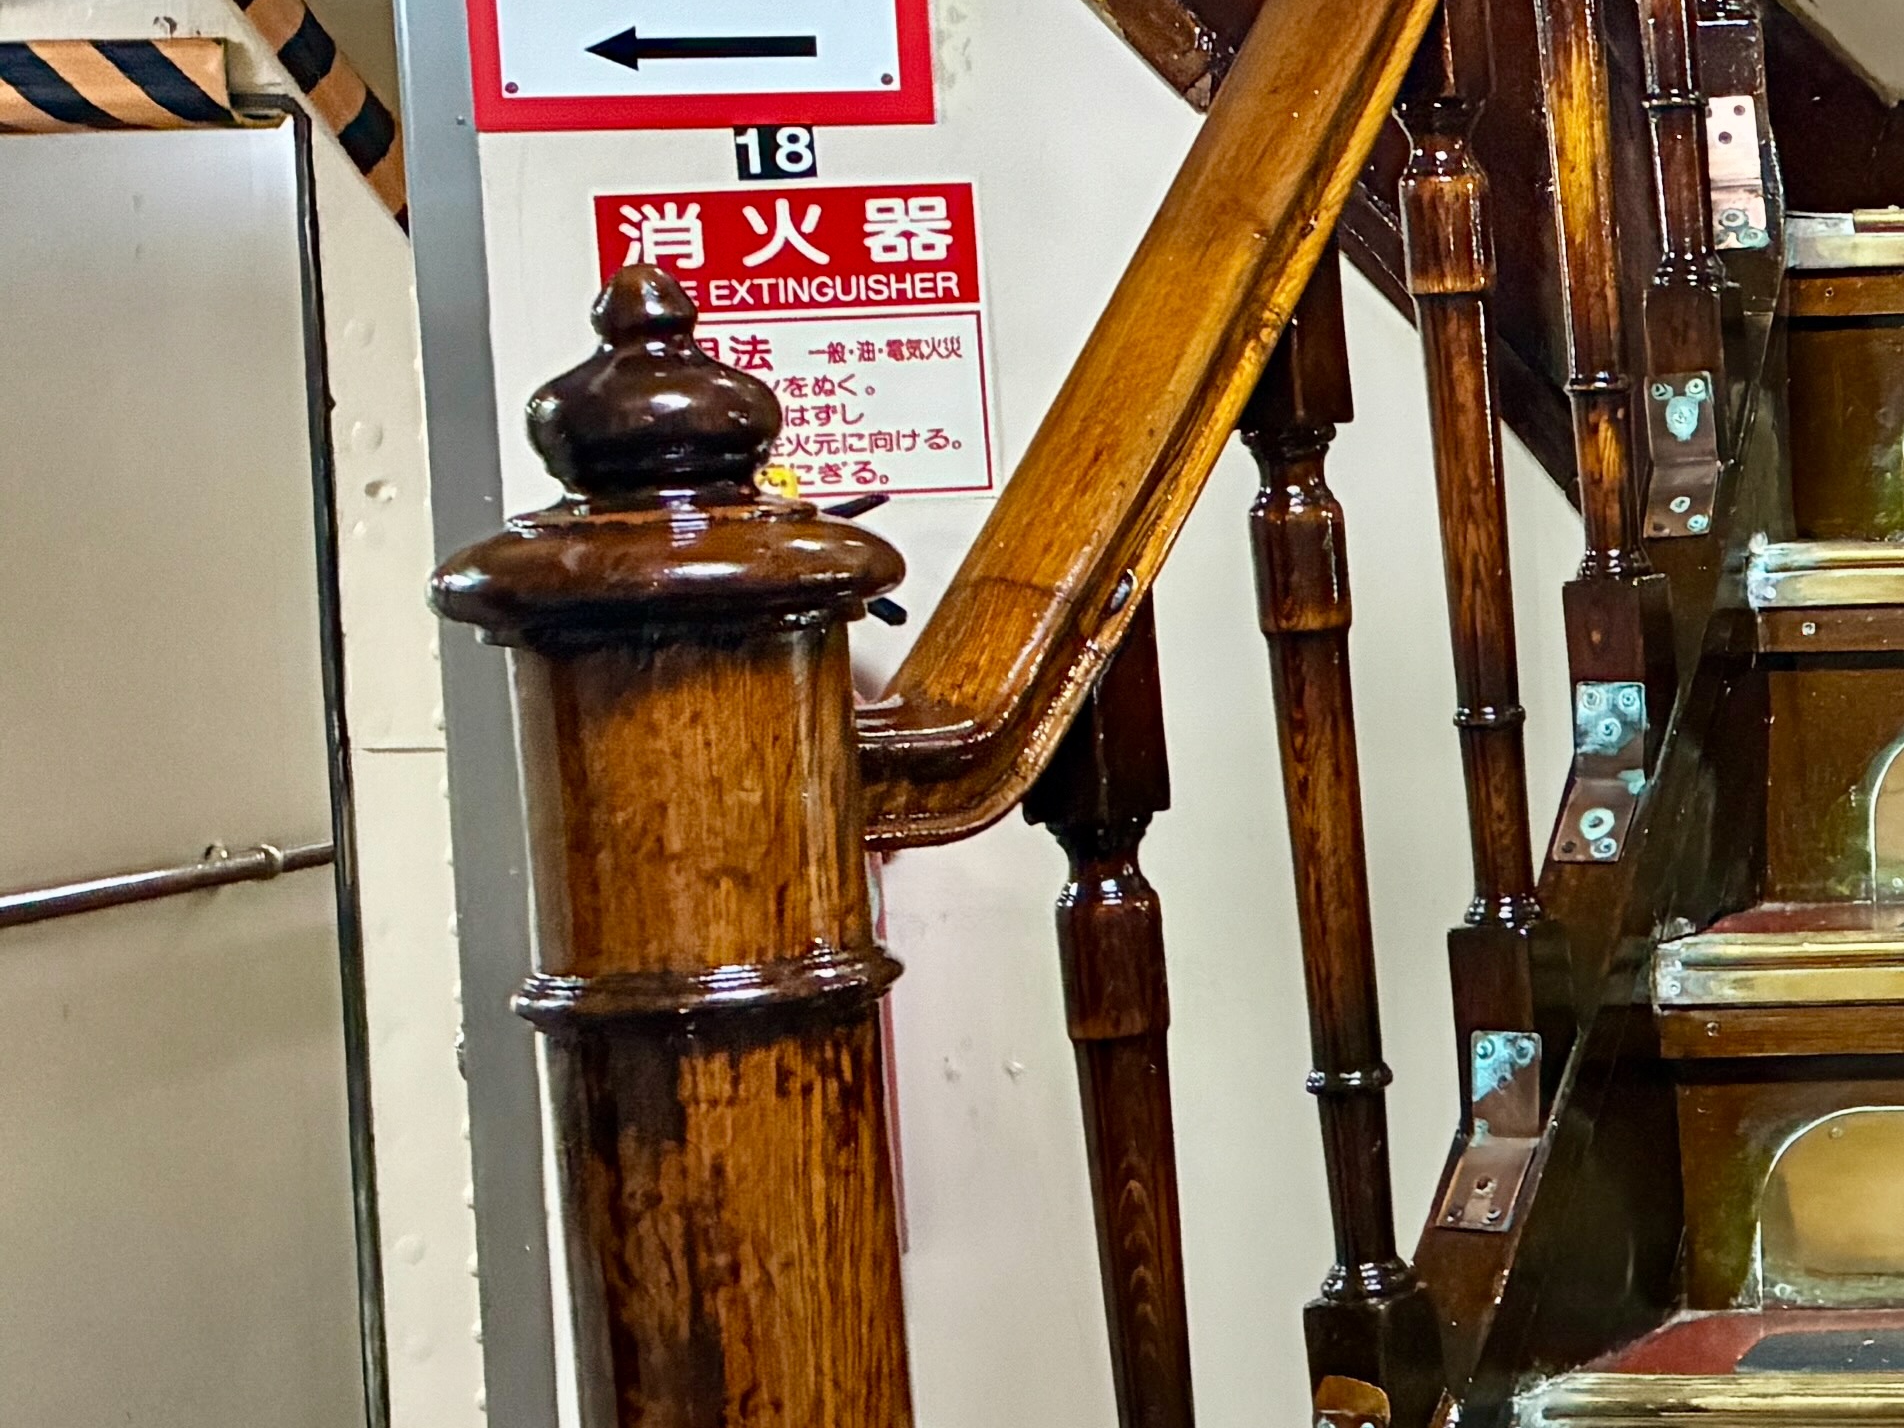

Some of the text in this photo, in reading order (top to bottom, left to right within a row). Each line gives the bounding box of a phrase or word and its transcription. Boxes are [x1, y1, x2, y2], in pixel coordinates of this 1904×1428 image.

[735, 127, 814, 177] 18
[618, 196, 954, 270] 消火器
[709, 272, 961, 307] EXTINGUISHER
